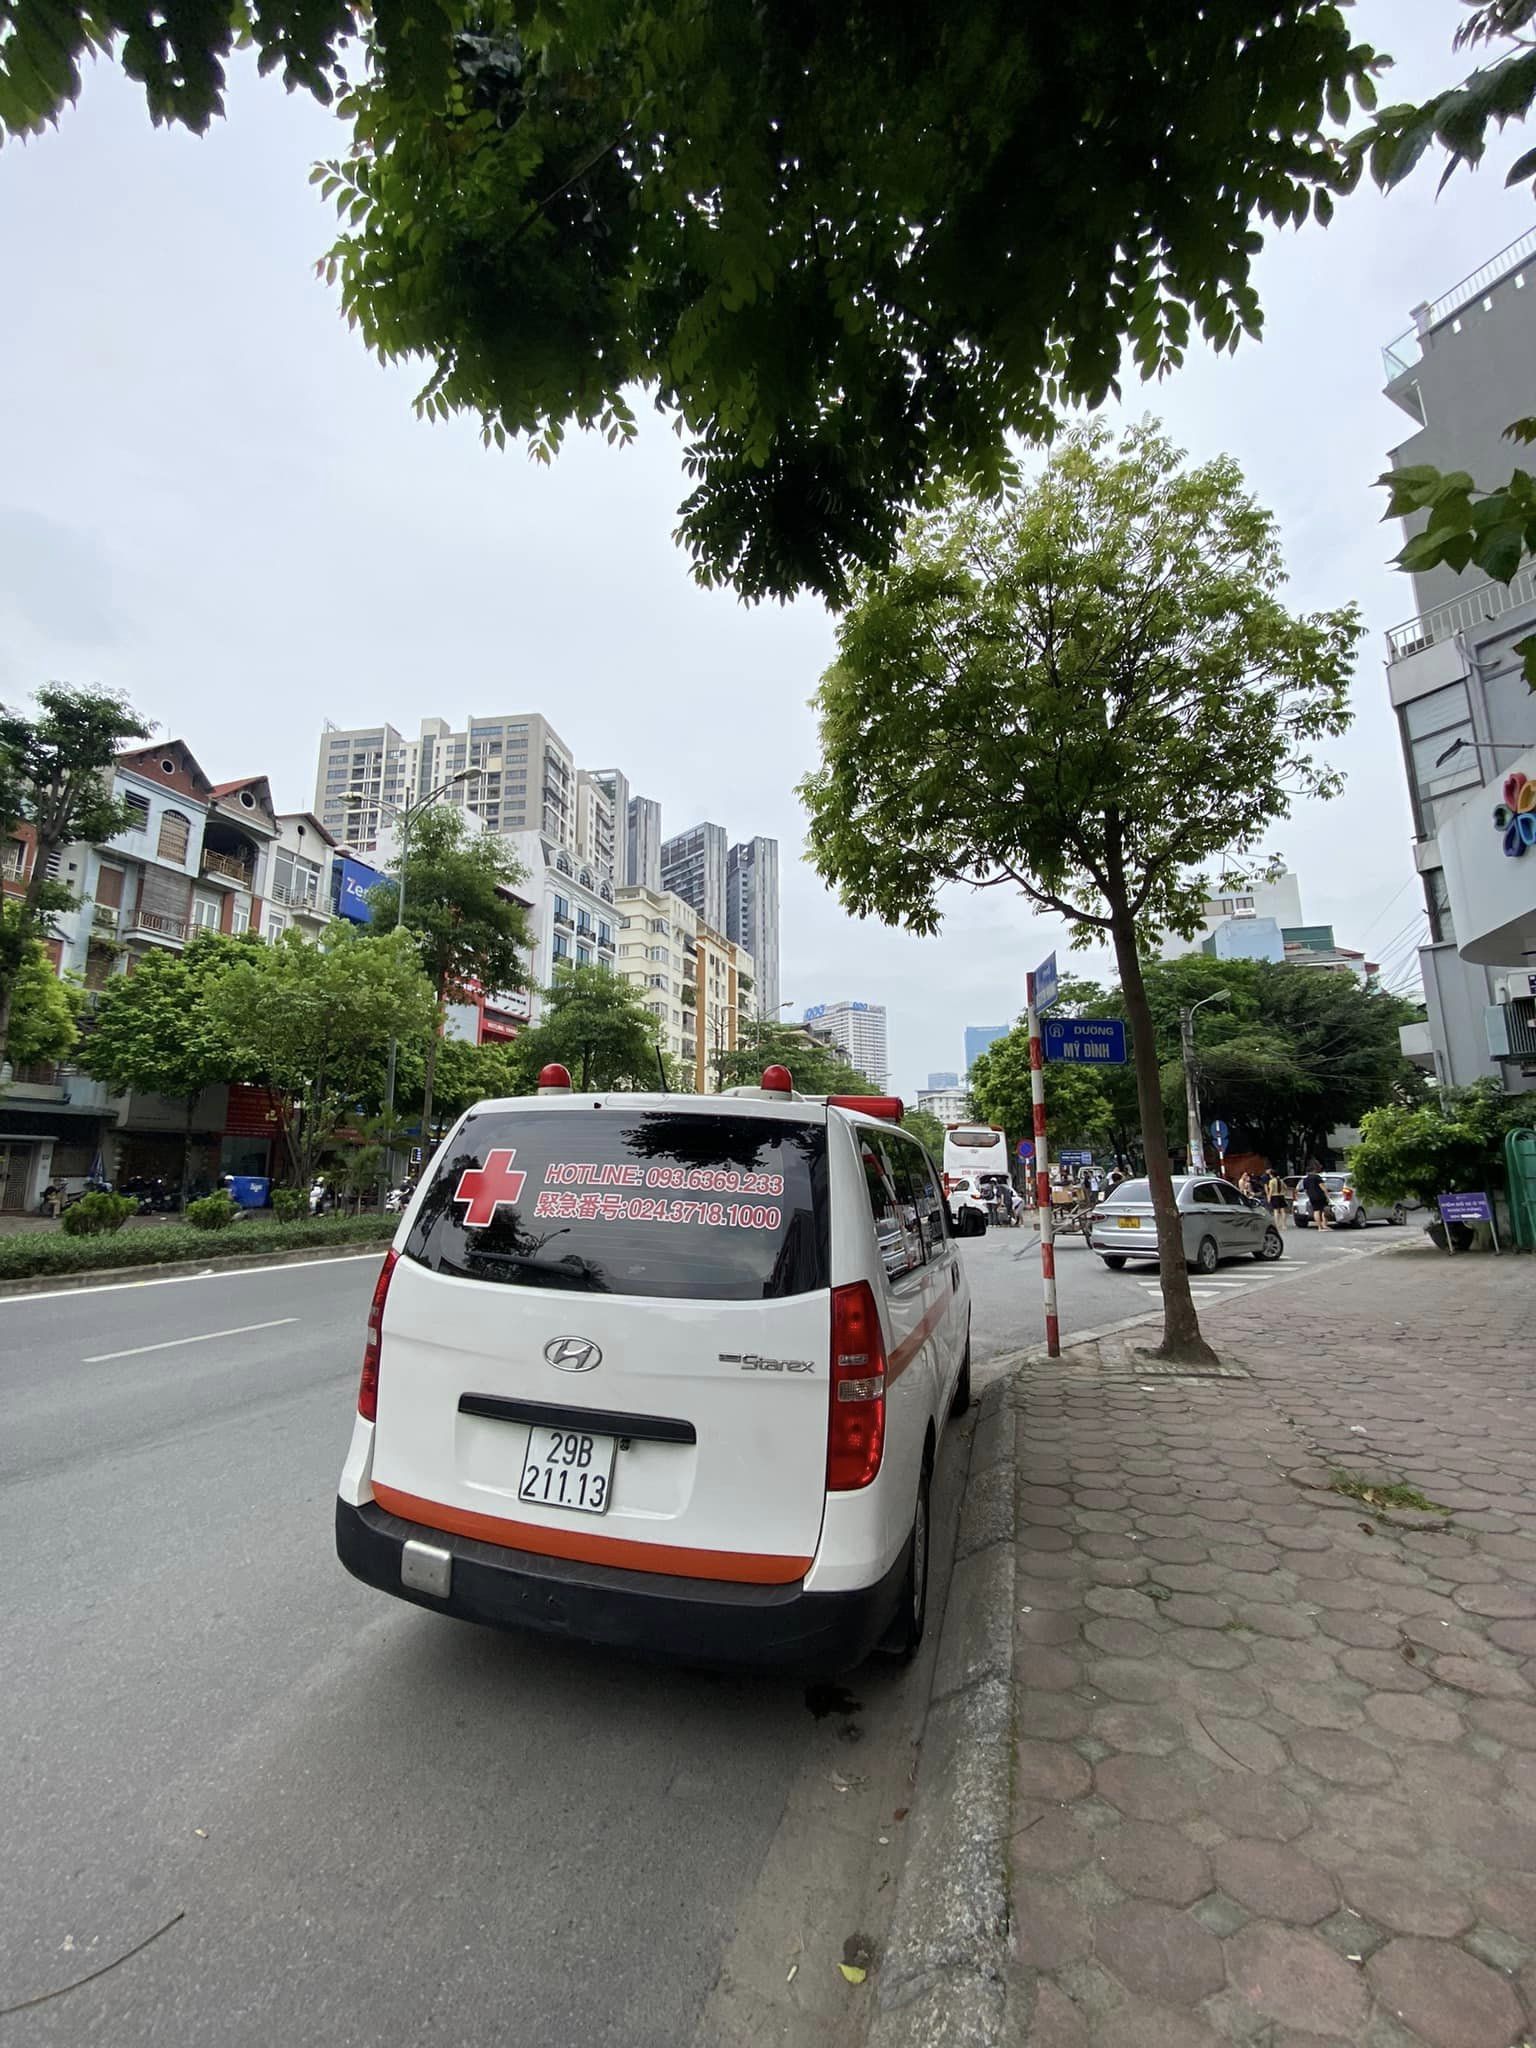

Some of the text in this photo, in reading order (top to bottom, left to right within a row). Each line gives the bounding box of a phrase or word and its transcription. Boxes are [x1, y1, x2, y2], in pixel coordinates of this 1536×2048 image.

[544, 1164, 784, 1195] HOTLINE: 093.6369.233
[741, 1355, 815, 1374] Starex
[546, 1432, 594, 1468] 29B
[522, 1465, 606, 1507] 211.13
